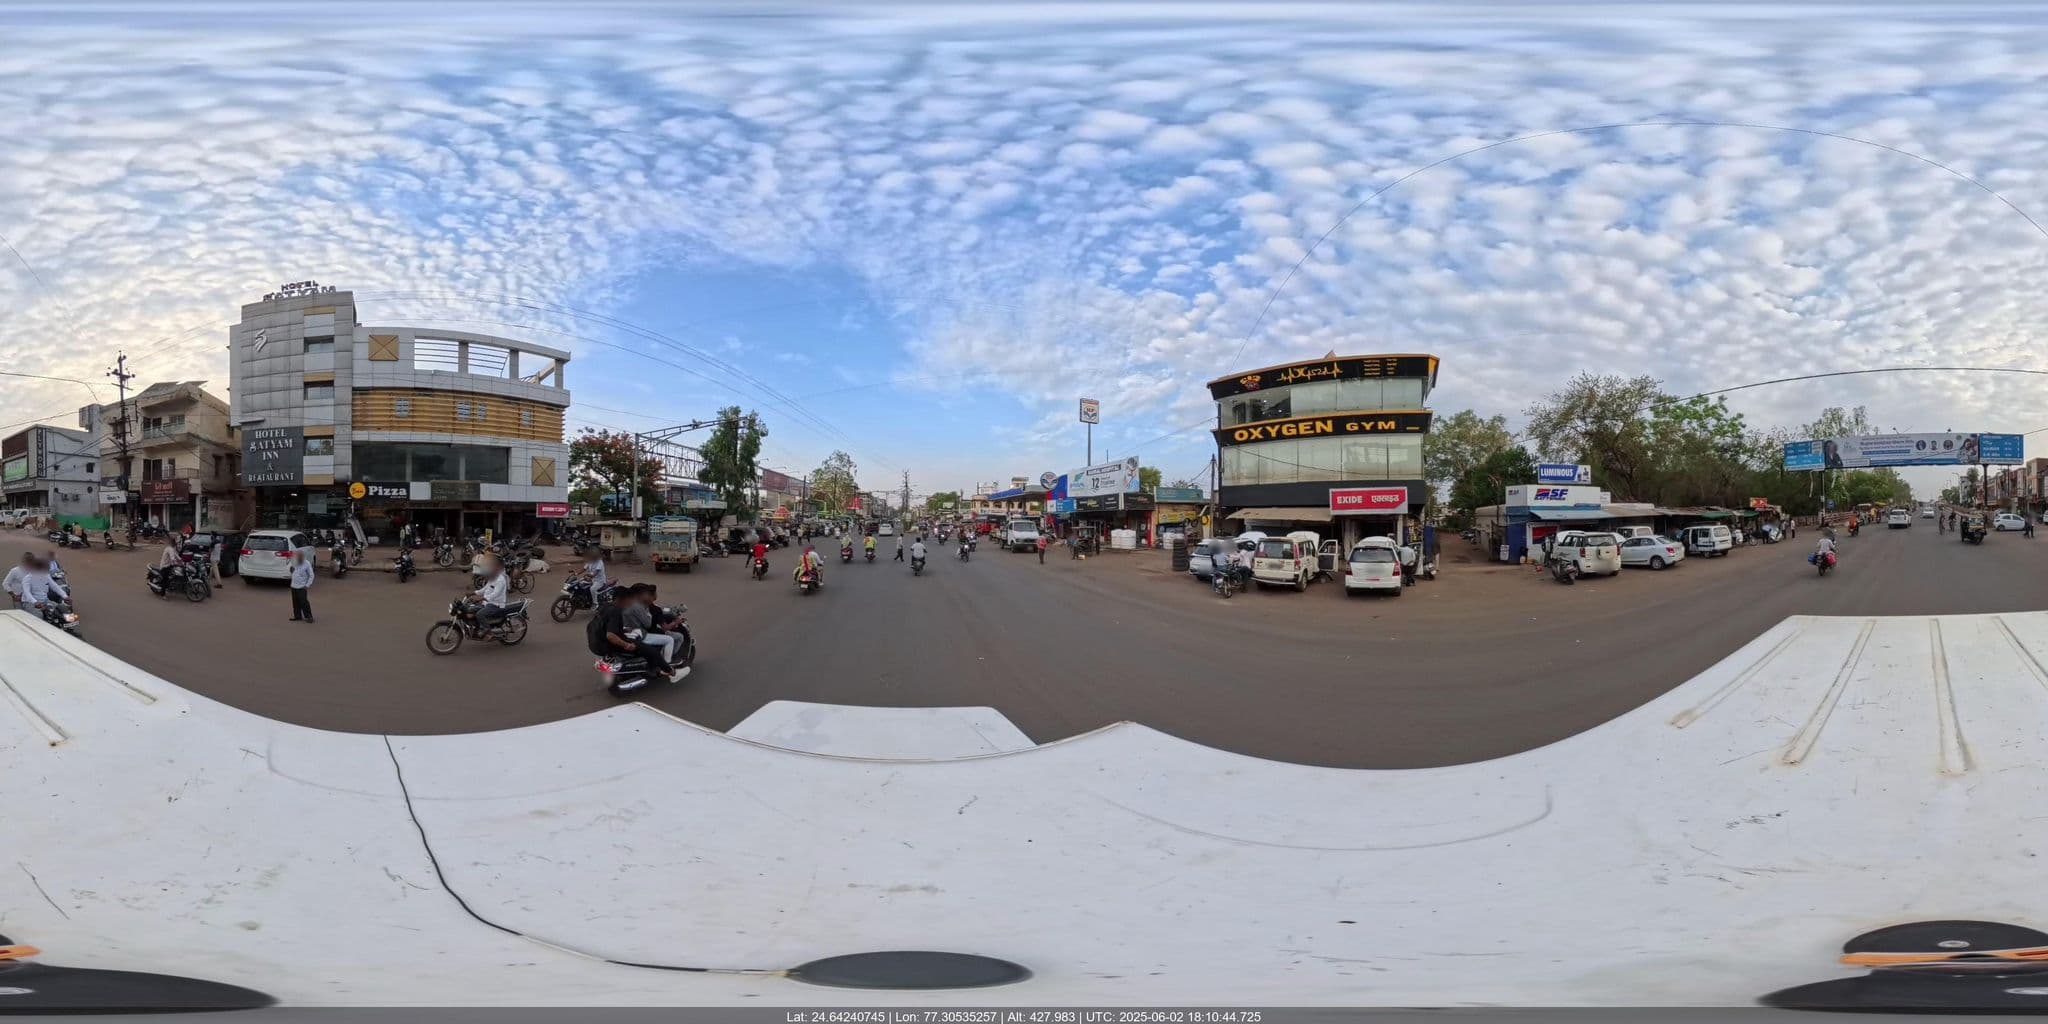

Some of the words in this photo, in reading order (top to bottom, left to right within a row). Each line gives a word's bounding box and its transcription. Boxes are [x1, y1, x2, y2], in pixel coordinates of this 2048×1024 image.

[281, 280, 319, 291] HOTEL
[255, 428, 287, 439] HOTEL
[1234, 419, 1333, 441] OXYGEN
[1346, 421, 1395, 432] GYM
[249, 439, 293, 452] SATYAM
[263, 450, 279, 461] INN
[248, 472, 295, 482] RESTAURANT
[1541, 468, 1574, 477] LUMINOUS
[1091, 478, 1100, 489] 12
[368, 485, 408, 496] Pizza
[1550, 489, 1569, 497] SF
[1337, 495, 1362, 504] EXIDE
